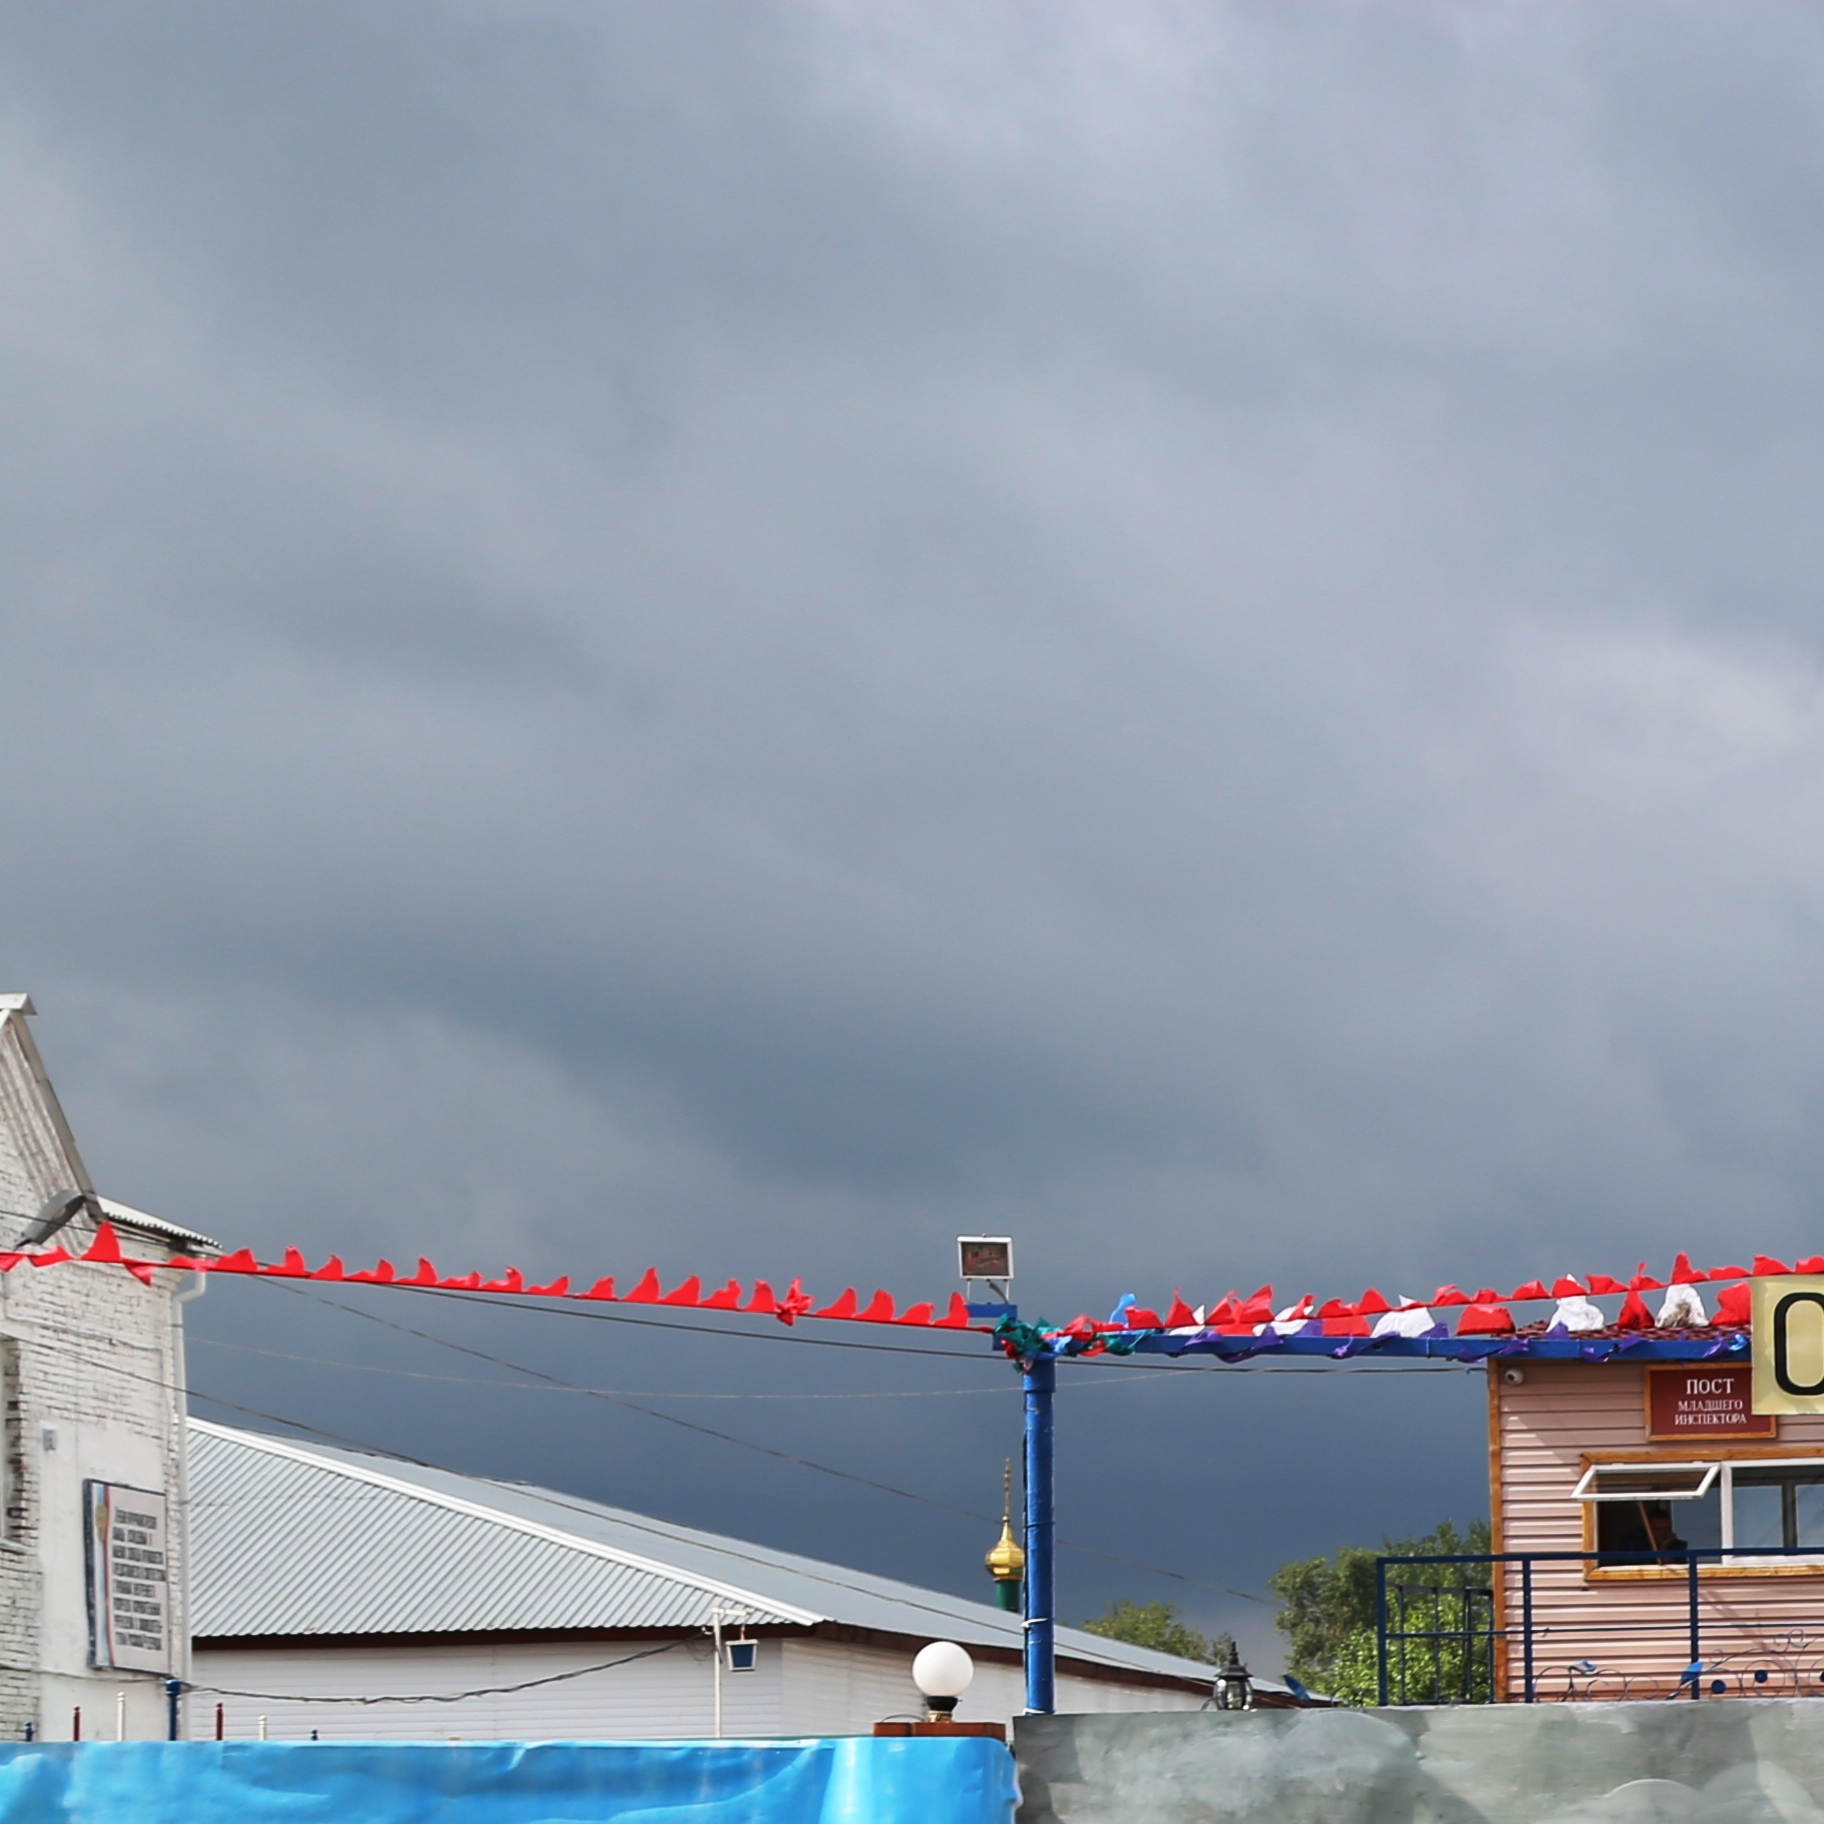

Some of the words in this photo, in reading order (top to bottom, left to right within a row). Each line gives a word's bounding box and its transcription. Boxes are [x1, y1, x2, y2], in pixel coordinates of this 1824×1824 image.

[1686, 1378, 1735, 1395] ПОСТ
[1677, 1399, 1744, 1412] МЛАДШЕГО
[1674, 1413, 1747, 1425] ИНСПЕКТОРА
